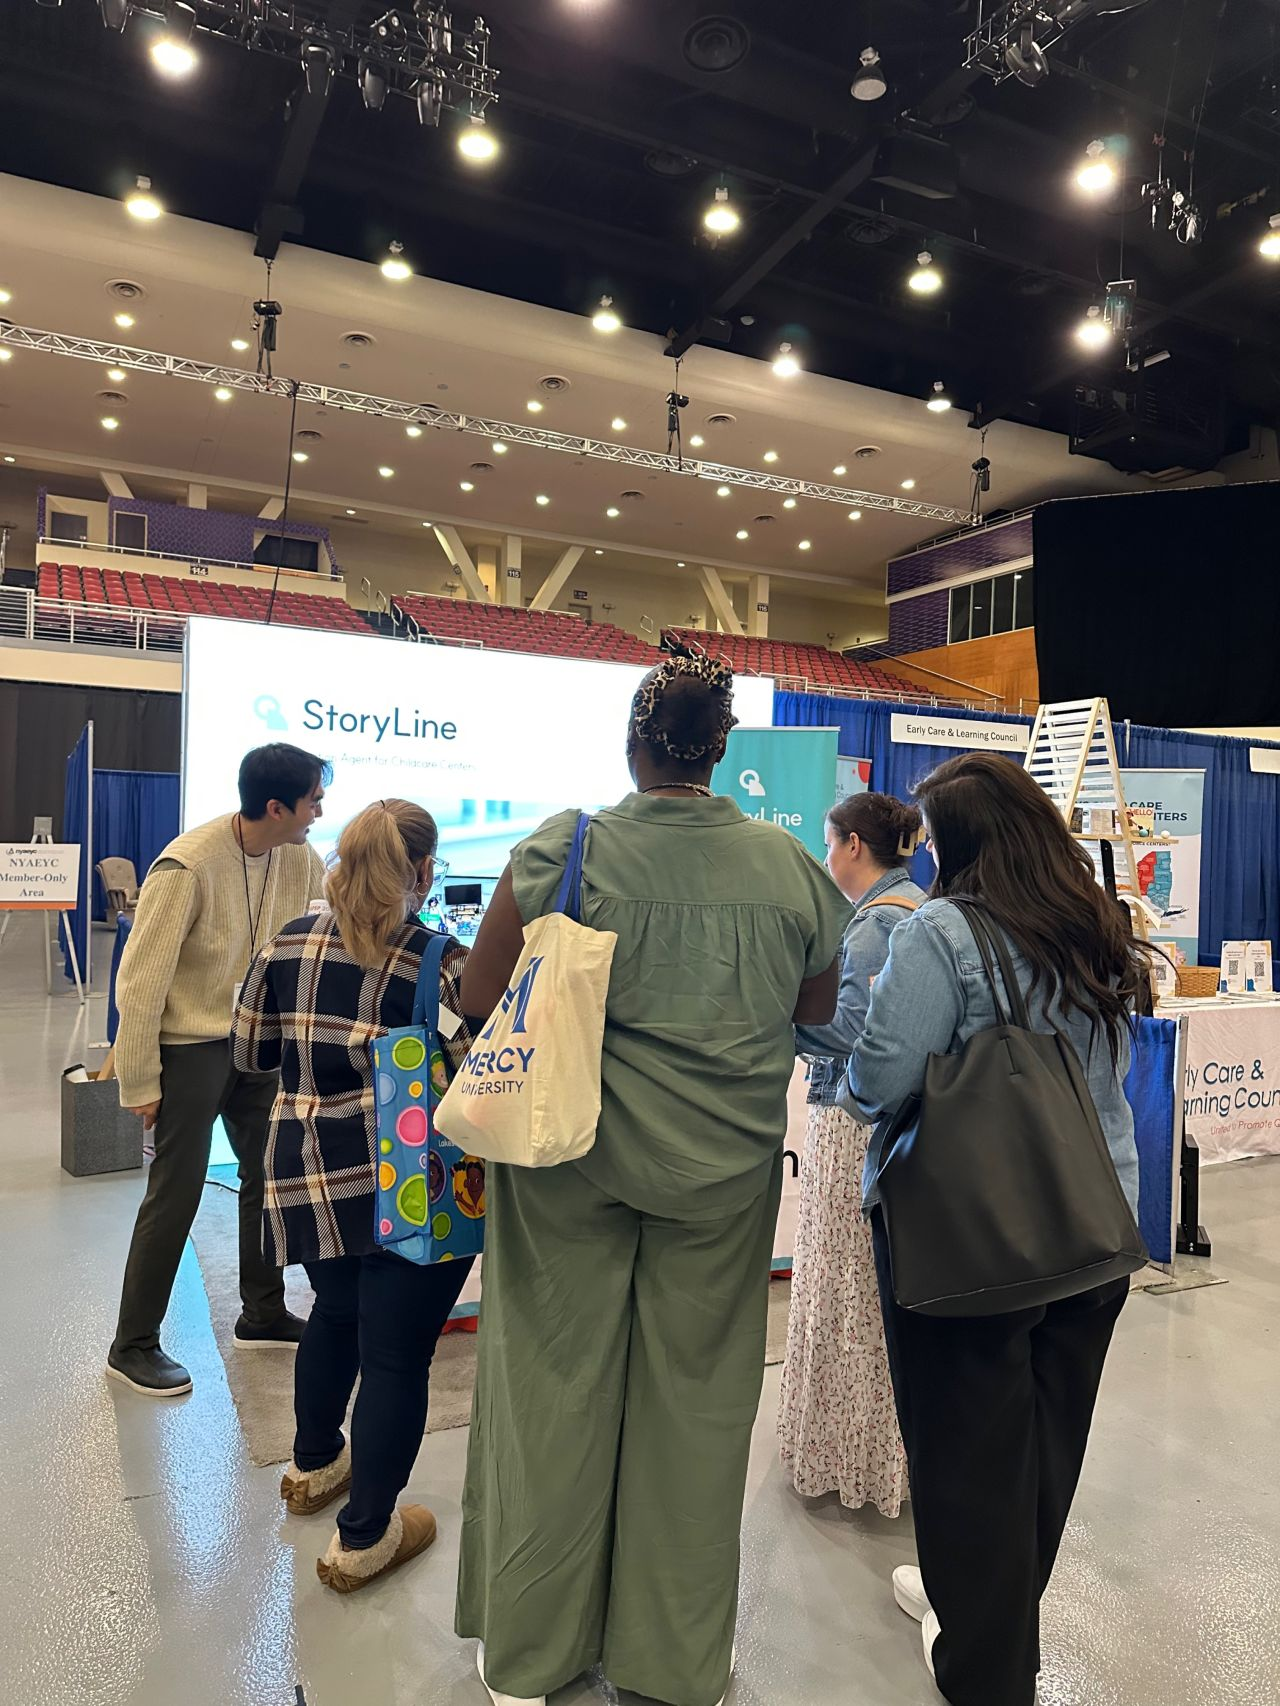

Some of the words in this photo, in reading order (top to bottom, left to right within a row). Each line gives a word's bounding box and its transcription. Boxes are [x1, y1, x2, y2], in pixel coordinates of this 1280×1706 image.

[508, 570, 520, 578] 115
[303, 699, 457, 742] StoryLine
[906, 724, 926, 736] Early
[927, 726, 946, 736] Care
[947, 728, 954, 736] &
[956, 728, 989, 741] Learning
[990, 732, 1018, 742] Council
[341, 753, 372, 766] Agent
[374, 755, 388, 765] for
[391, 756, 438, 768] Childcare
[9, 858, 59, 868] NYAEYC
[0, 873, 68, 884] Member-Only
[19, 888, 44, 897] Area
[461, 1047, 535, 1077] MERCY
[1203, 1062, 1245, 1085] Care
[1251, 1059, 1265, 1080] &
[1210, 1124, 1231, 1136] United
[1237, 1119, 1273, 1130] Promote
